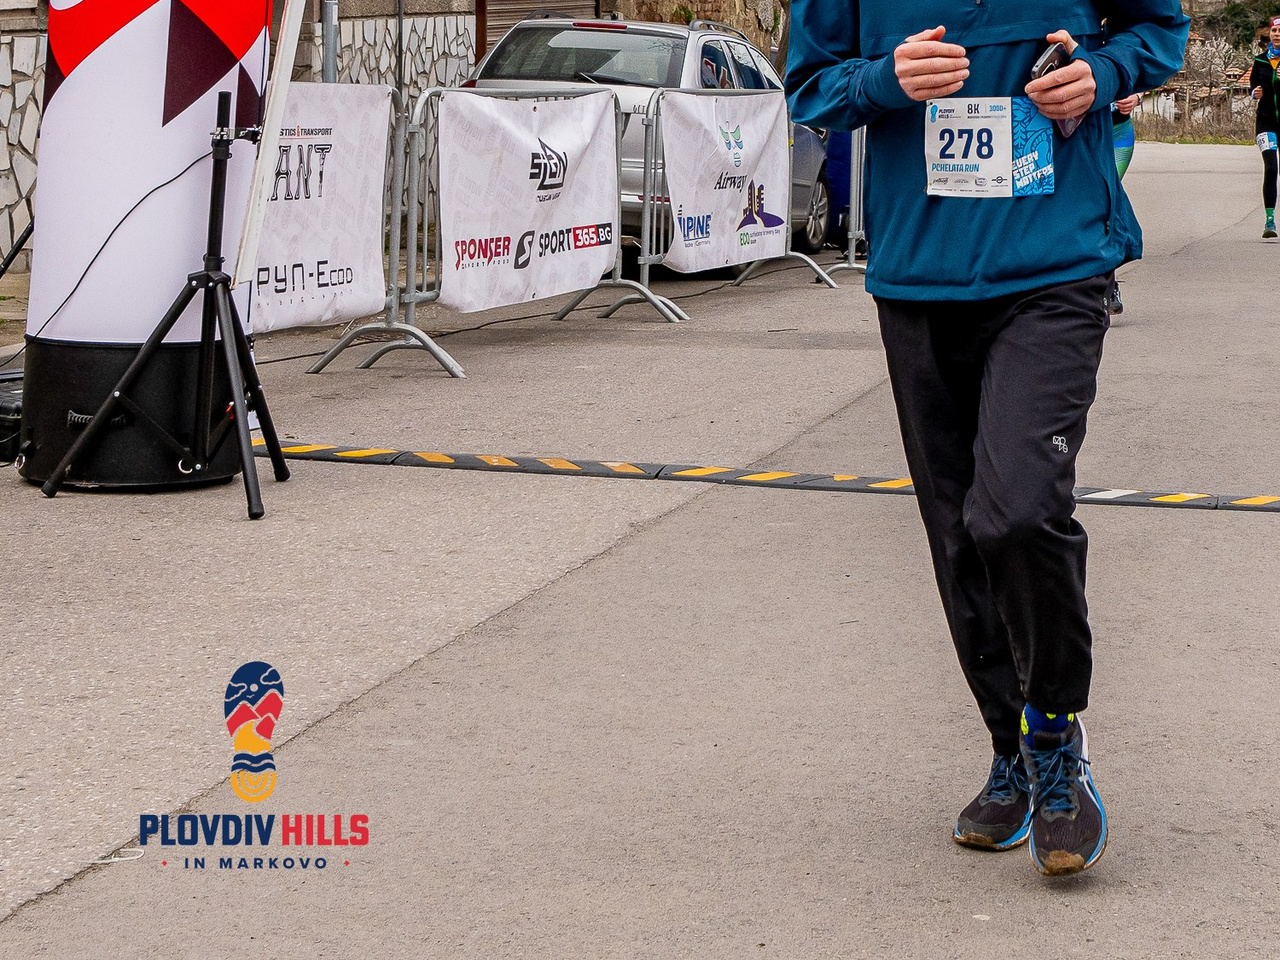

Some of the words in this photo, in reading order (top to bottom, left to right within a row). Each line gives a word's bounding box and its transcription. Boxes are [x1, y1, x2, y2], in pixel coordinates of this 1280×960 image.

[967, 103, 980, 114] 8K
[300, 127, 333, 136] TRANSPORT
[939, 127, 994, 160] 278
[931, 163, 964, 172] PCHELATA
[964, 163, 980, 173] RUN
[1012, 150, 1039, 171] EVERY
[714, 171, 748, 193] Airway
[1012, 163, 1035, 180] STEP
[1015, 163, 1054, 189] MATTERS
[454, 236, 511, 271] SPONSER
